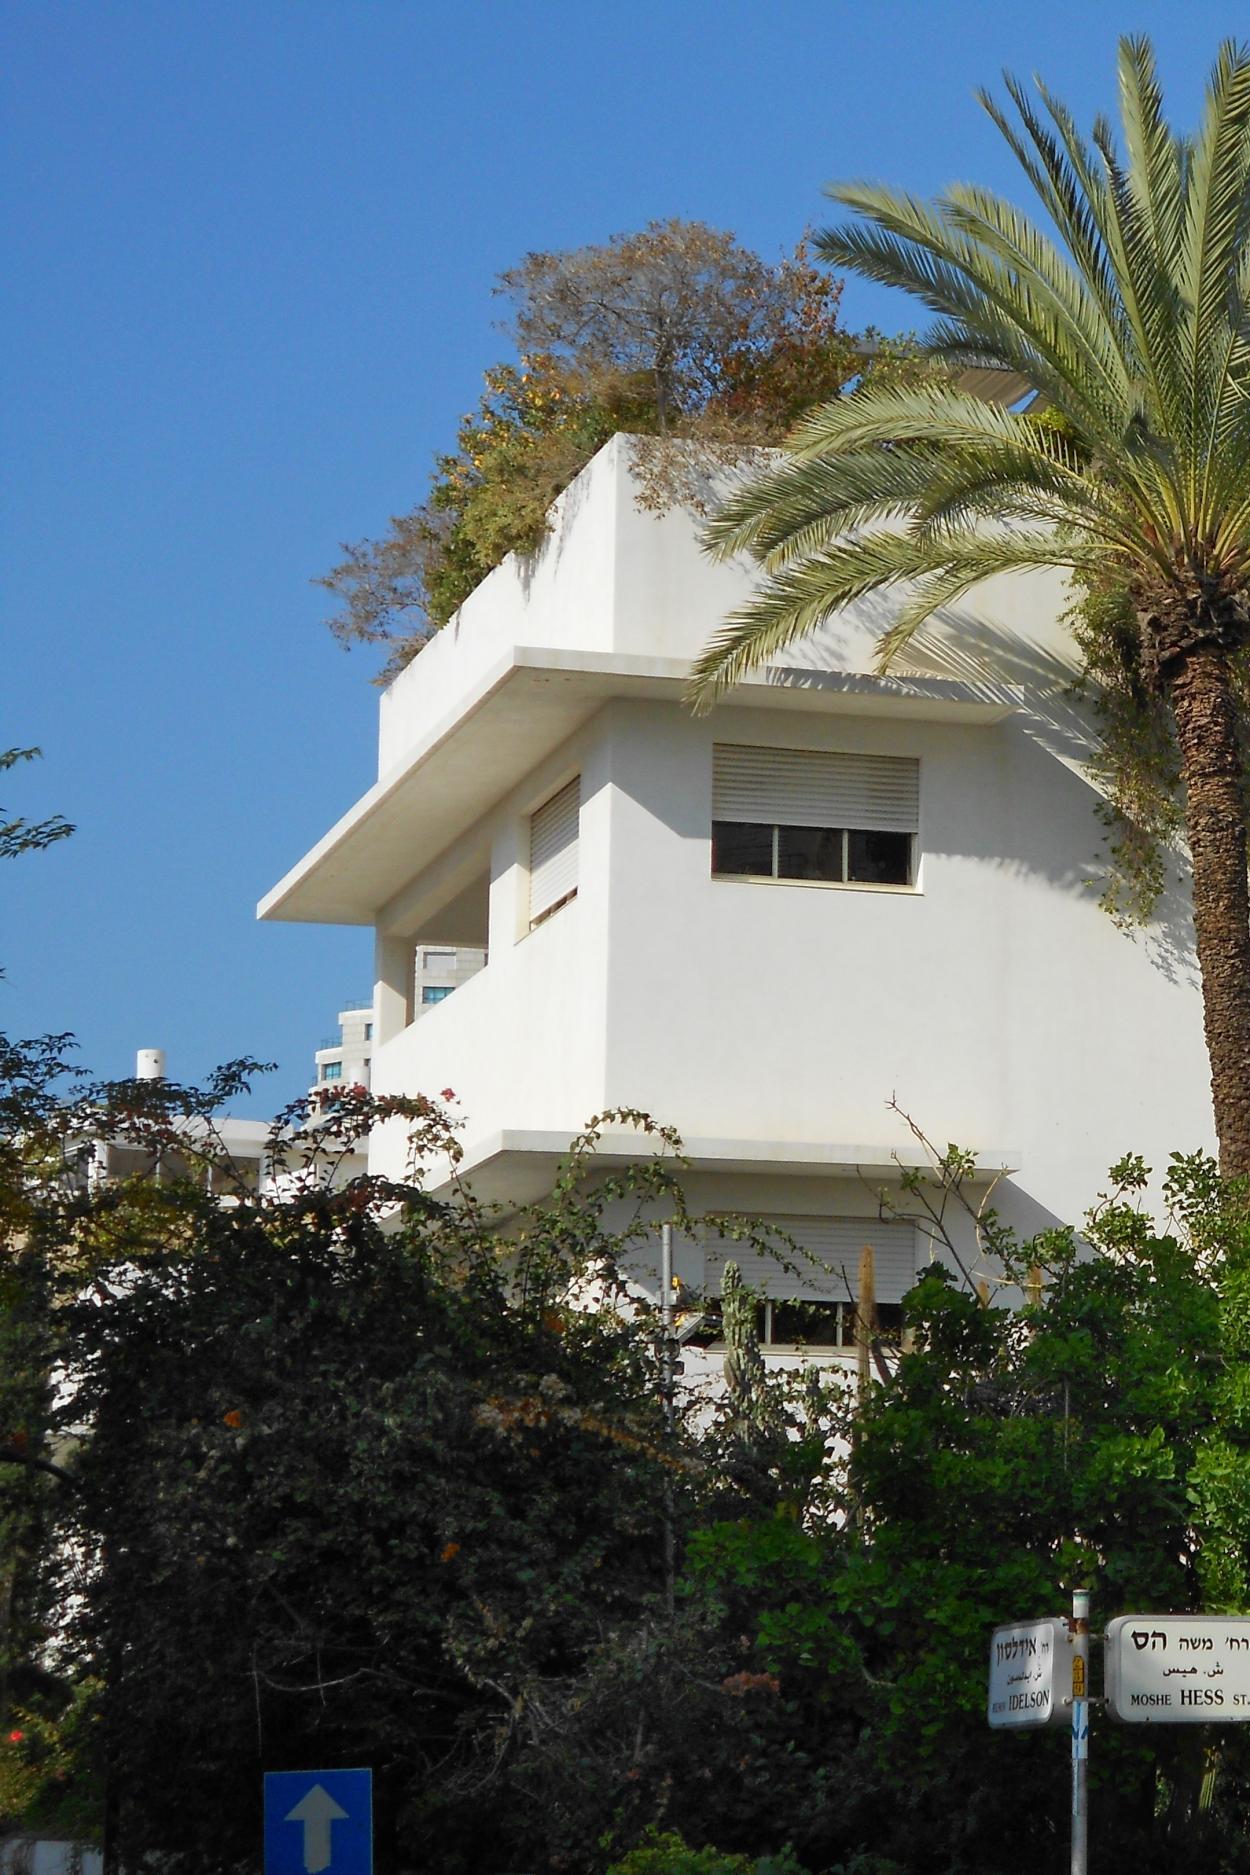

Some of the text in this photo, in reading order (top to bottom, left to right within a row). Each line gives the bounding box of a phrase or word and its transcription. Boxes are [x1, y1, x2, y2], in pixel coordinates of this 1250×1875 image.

[1130, 1630, 1250, 1651] רח' משה הס
[996, 1636, 1037, 1667] אידלסון
[1162, 1665, 1198, 1678] هيس
[1008, 1689, 1050, 1711] IDELSON
[1130, 1689, 1250, 1706] MOSHE HESS ST.
